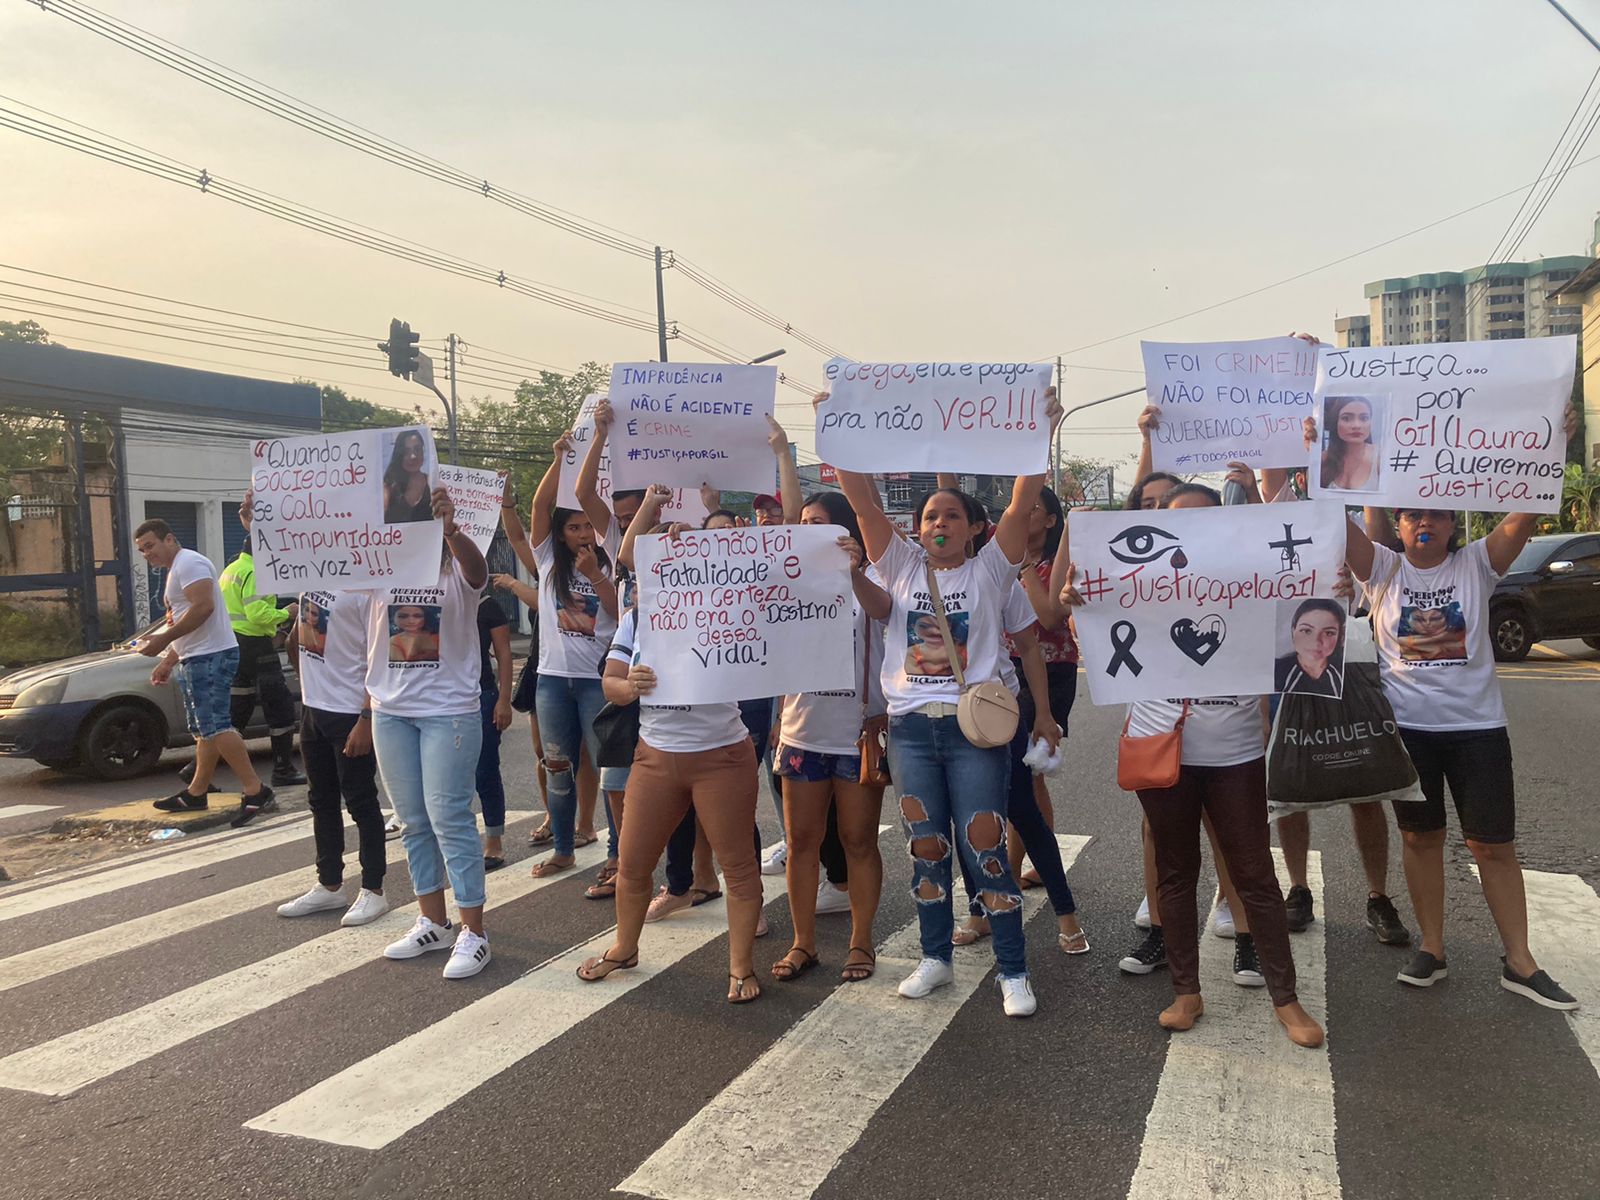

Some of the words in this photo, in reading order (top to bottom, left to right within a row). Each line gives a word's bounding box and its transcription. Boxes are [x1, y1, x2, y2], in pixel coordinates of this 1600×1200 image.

[979, 362, 1034, 385] paga
[1164, 354, 1200, 371] FOI
[1215, 352, 1317, 376] CRIME!!!
[622, 368, 723, 385] IMPRUDÊNCIA
[630, 393, 662, 412] NÃO
[665, 393, 677, 413] É
[680, 400, 753, 415] ACIDENTE
[1161, 380, 1204, 405] NÃO
[1217, 386, 1251, 404] FOI
[1416, 386, 1476, 420] por
[627, 419, 638, 436] É
[644, 422, 693, 439] CRIME
[821, 411, 867, 434] pra
[875, 403, 923, 431] não
[1156, 417, 1253, 444] QUEREMOS
[348, 442, 363, 461] a
[627, 448, 729, 462] #JUSTIÇAPORGIL
[1435, 449, 1564, 479] Queremos
[257, 529, 273, 551] A
[784, 555, 801, 580] e
[390, 587, 445, 597] QUEREMOS
[393, 595, 438, 604] JUSTIÇA
[650, 609, 688, 632] não
[695, 610, 735, 629] era
[742, 609, 755, 624] o
[698, 626, 761, 647] dessa
[1284, 720, 1396, 746] RIACHUELO
